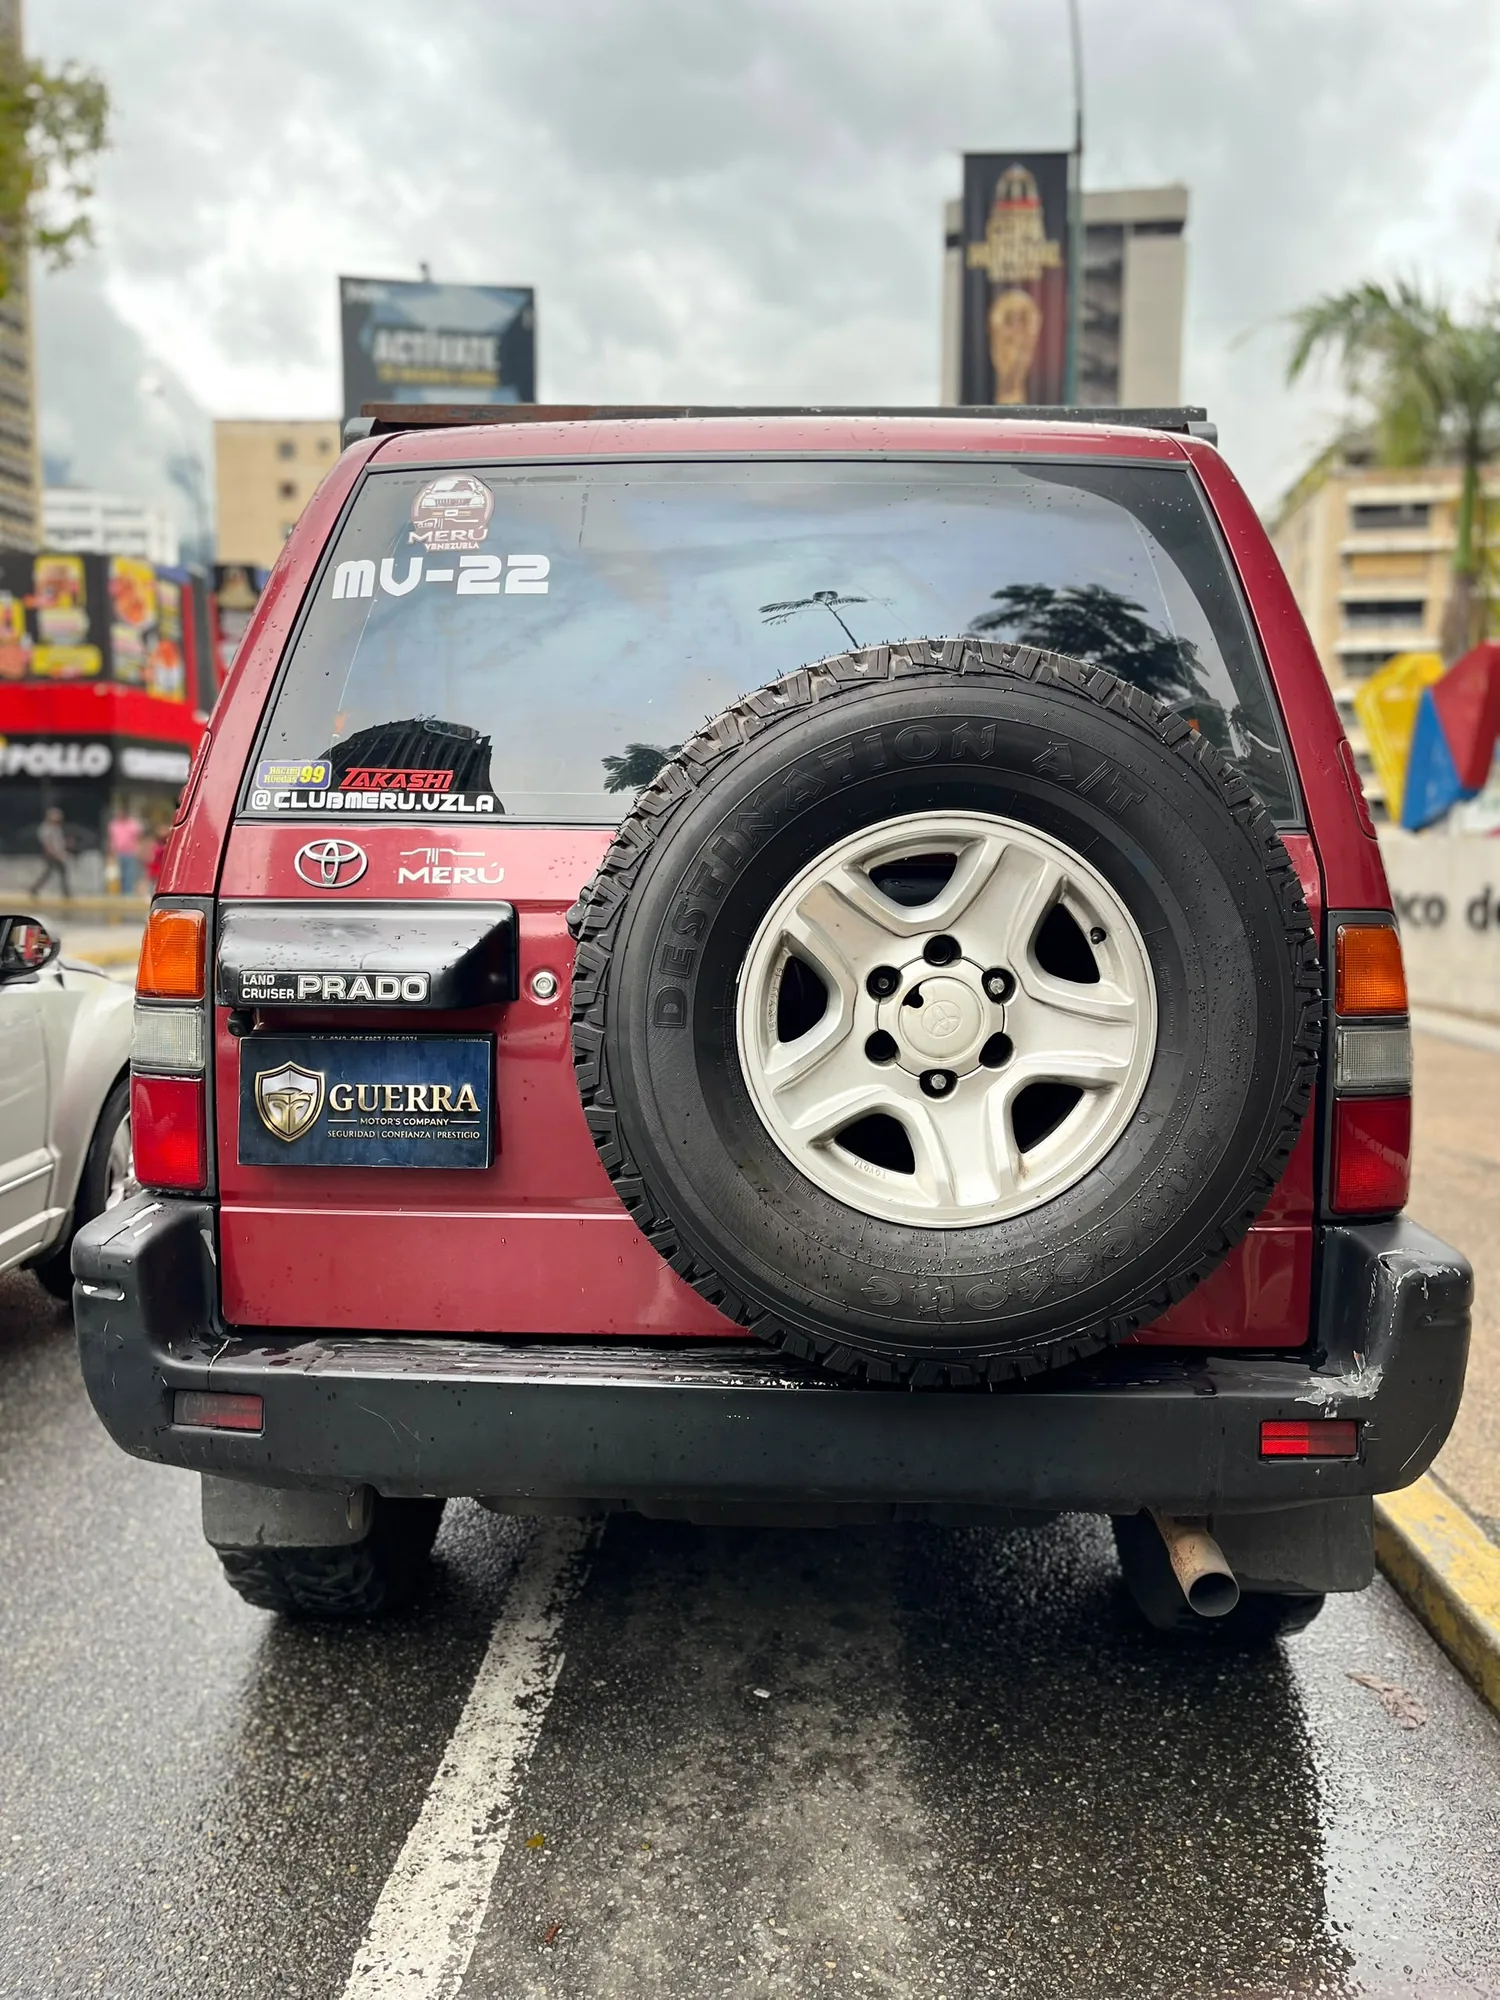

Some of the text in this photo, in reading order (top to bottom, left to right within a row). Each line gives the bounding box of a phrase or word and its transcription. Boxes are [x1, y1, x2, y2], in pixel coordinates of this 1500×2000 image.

[408, 525, 488, 544] MERÚ
[424, 541, 479, 550] VENEZUELA
[300, 765, 326, 784] 99
[339, 768, 455, 793] TAKASHI
[398, 861, 505, 885] MERÚ
[654, 721, 998, 1029] DESTINATION
[242, 974, 275, 986] LAND
[242, 974, 428, 1002] CRUISER PRADO
[328, 1083, 481, 1113] GUERRA
[360, 1117, 450, 1126] MOTOR'S COMPANY
[327, 1130, 480, 1140] SEGURIDAD CONFIANZA PRESTIGIO
[853, 1157, 887, 1180] TOYOTA
